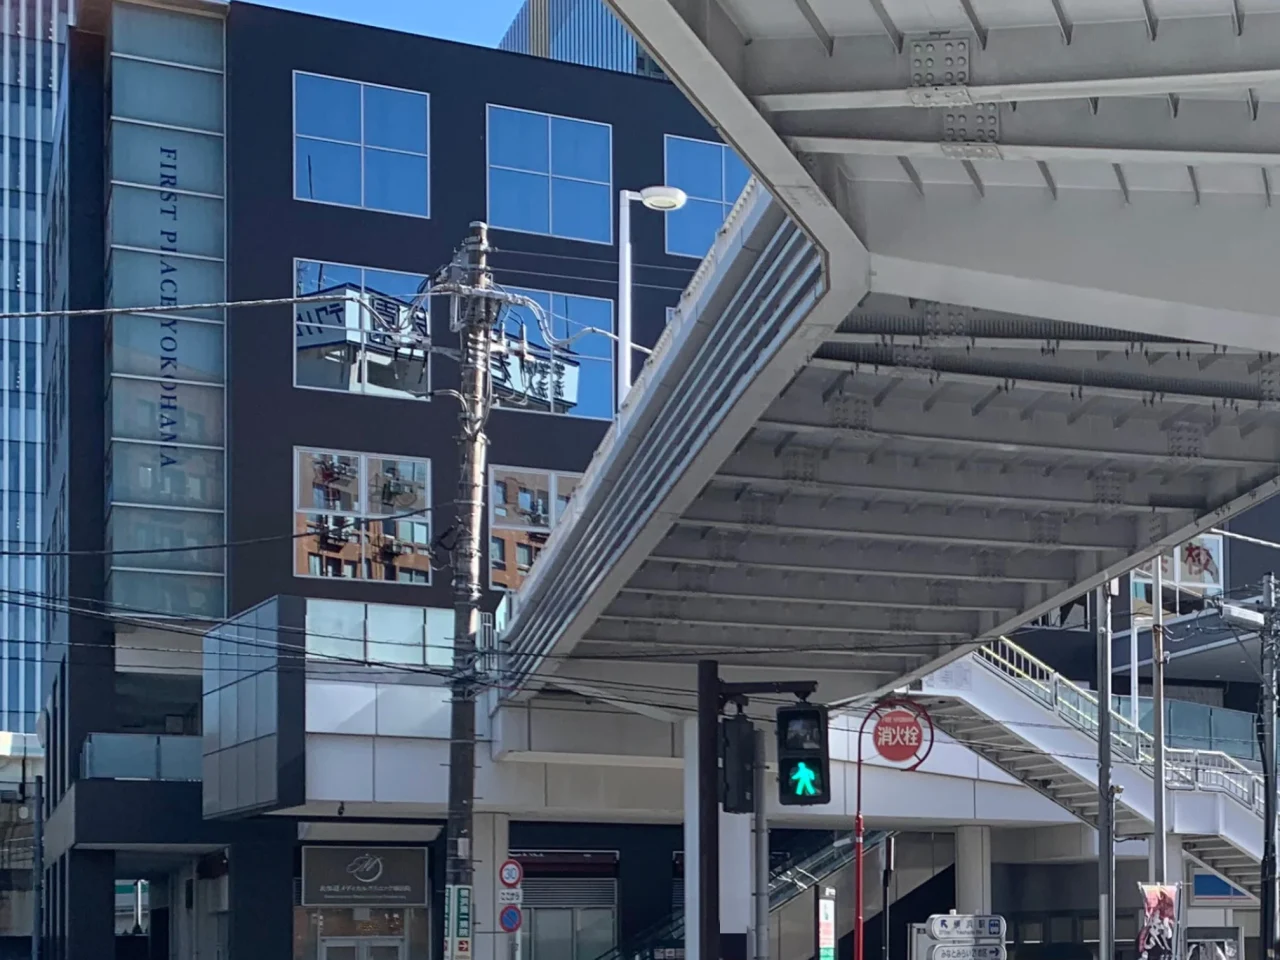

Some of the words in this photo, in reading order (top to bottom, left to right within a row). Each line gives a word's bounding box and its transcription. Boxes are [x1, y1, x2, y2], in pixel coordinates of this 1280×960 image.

[160, 147, 177, 221] FIRST
[160, 230, 177, 307] PLACE
[160, 319, 177, 467] YOKOHAMA
[877, 726, 919, 746] 消火栓
